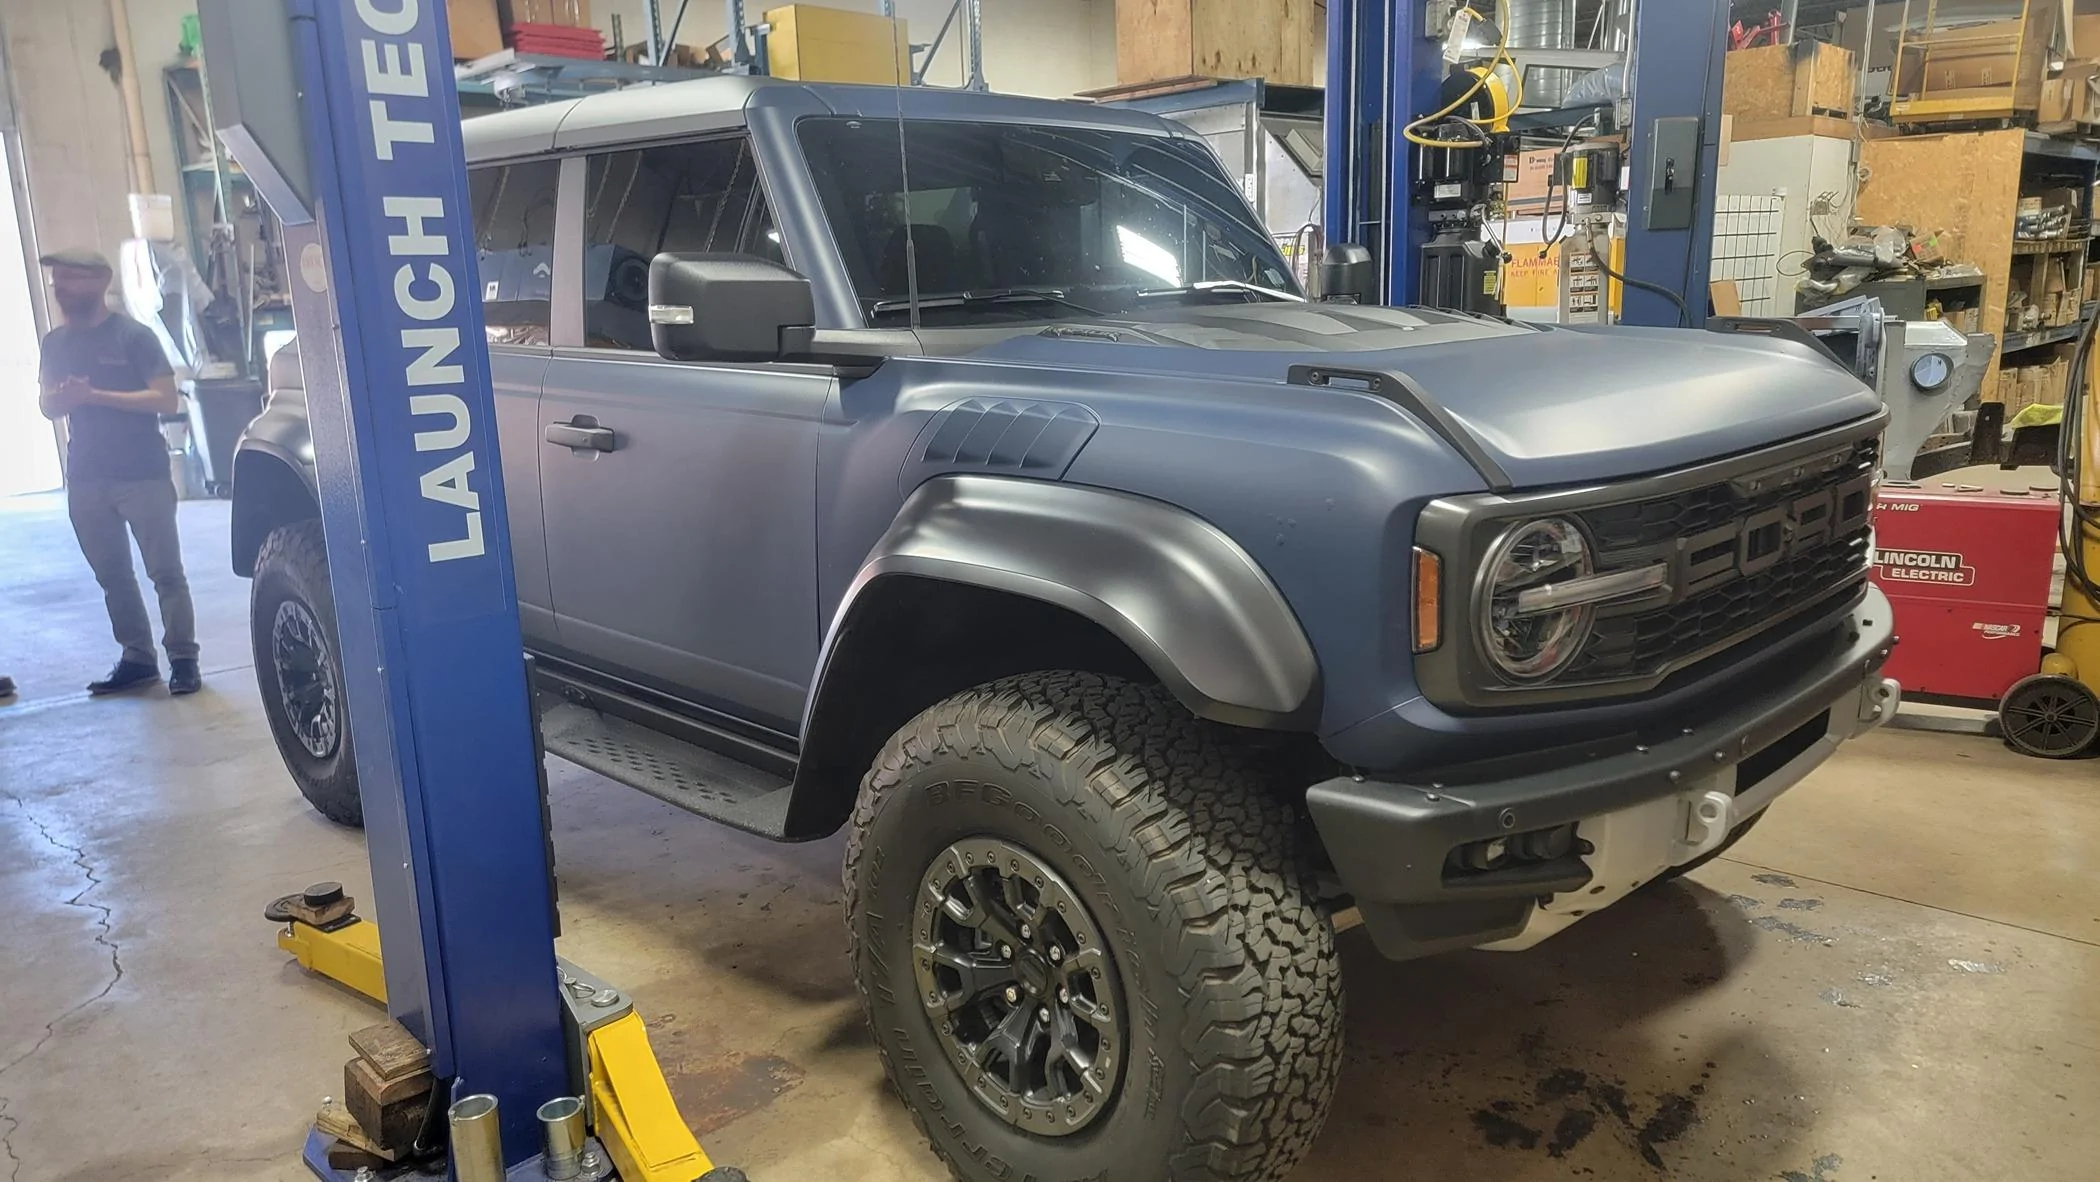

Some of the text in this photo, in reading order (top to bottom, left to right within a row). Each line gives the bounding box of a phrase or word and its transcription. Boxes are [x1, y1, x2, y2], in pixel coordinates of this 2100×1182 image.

[384, 195, 486, 563] LAUNCH
[1891, 503, 1919, 511] MIG
[1874, 552, 1956, 569] LINCOLN
[1892, 568, 1964, 582] ELECTRIC
